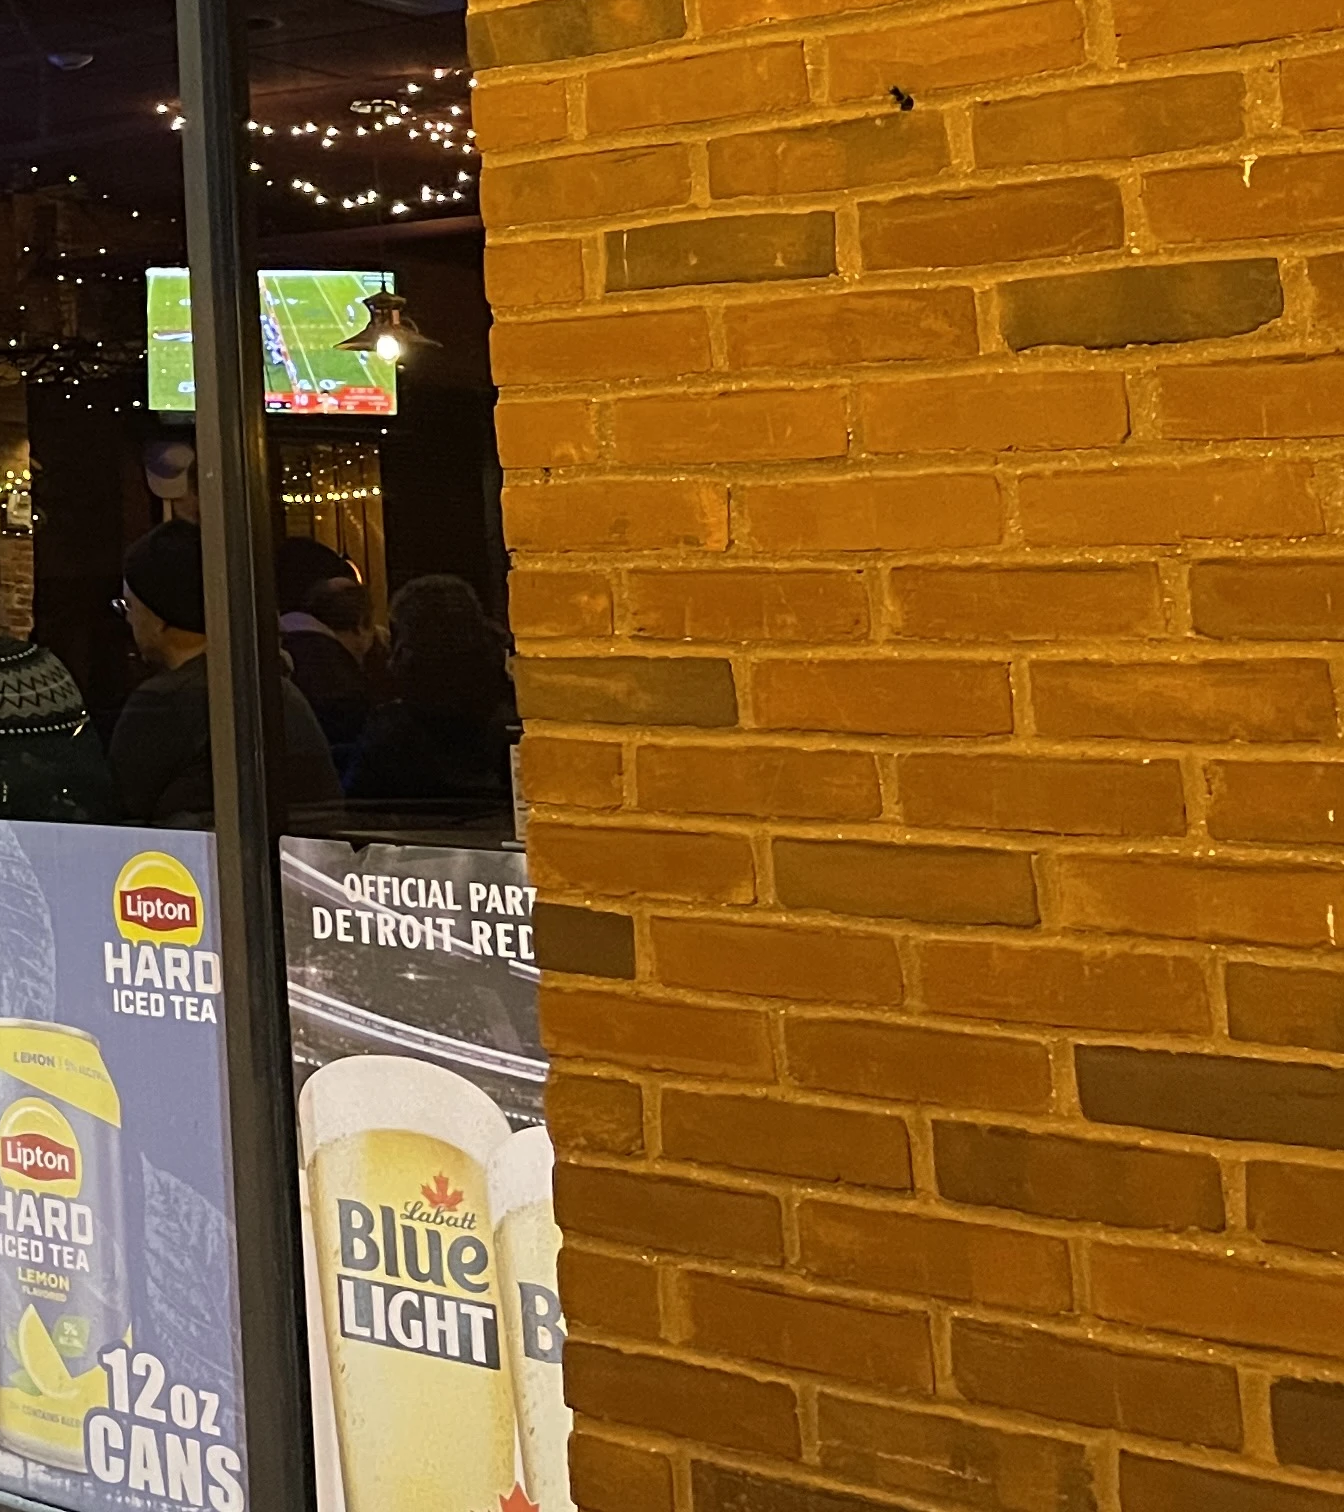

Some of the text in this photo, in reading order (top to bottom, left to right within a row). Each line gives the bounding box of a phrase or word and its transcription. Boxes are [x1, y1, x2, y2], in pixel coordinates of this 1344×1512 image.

[126, 894, 191, 923] Lipton
[344, 873, 462, 910] OFFICIAL
[312, 906, 535, 960] DETROIT RED
[104, 941, 222, 995] HARD
[113, 988, 217, 1024] ICED TEA
[13, 1051, 55, 1068] LEMON
[6, 1140, 70, 1173] Lipton
[400, 1200, 477, 1230] Labatt
[48, 1243, 90, 1273] TEA
[337, 1198, 490, 1293] Blue
[17, 1266, 70, 1292] LEMON
[341, 1278, 493, 1364] LIGHT
[89, 1415, 246, 1512] CANS
